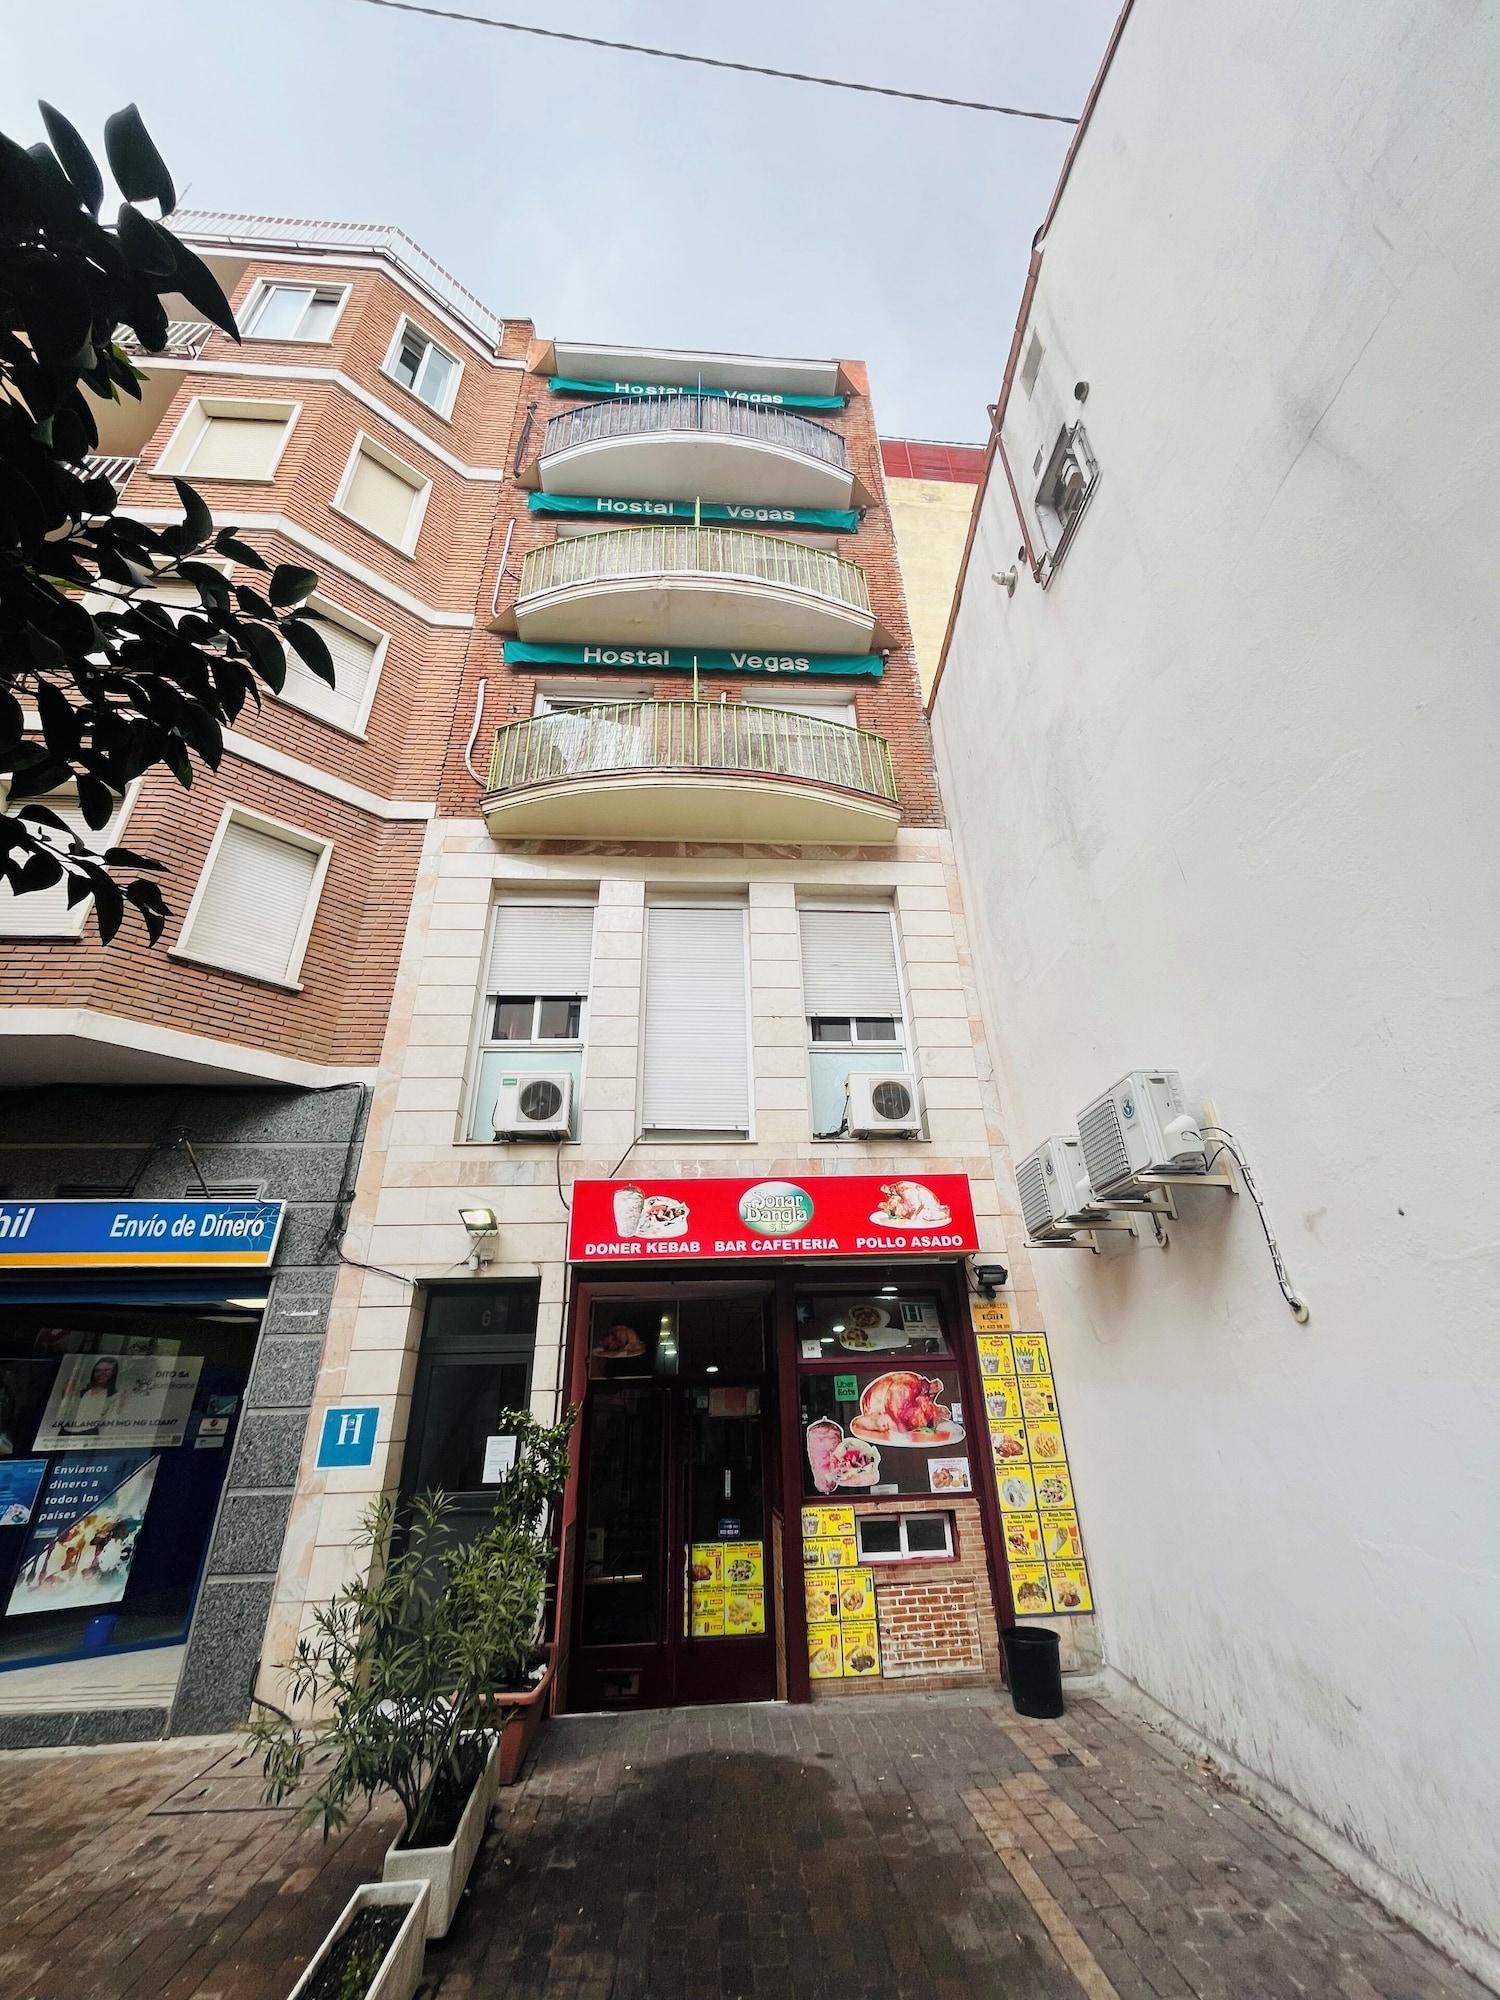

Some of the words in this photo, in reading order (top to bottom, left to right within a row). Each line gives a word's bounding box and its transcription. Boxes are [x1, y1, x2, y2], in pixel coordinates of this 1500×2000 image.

[614, 383, 683, 395] Hostal
[724, 390, 784, 404] Vegas
[597, 498, 674, 515] Hostal
[727, 506, 796, 522] Vegas
[584, 647, 670, 666] Hostal
[731, 653, 810, 672] Vegas
[748, 1190, 804, 1209] Sonar
[744, 1206, 809, 1225] Bangla
[110, 1213, 167, 1237] Envío
[171, 1213, 195, 1237] de
[199, 1213, 265, 1237] Dinero
[585, 1241, 642, 1255] DONER
[645, 1241, 701, 1254] KEBAB
[714, 1239, 746, 1252] BAR
[750, 1238, 839, 1251] CAFETERIA
[856, 1236, 907, 1249] POLLO
[910, 1235, 964, 1247] ASADO
[54, 1464, 108, 1475] Enviamos
[49, 1480, 88, 1490] dinero
[91, 1480, 99, 1488] a
[45, 1495, 79, 1505] todos
[82, 1494, 99, 1504] los
